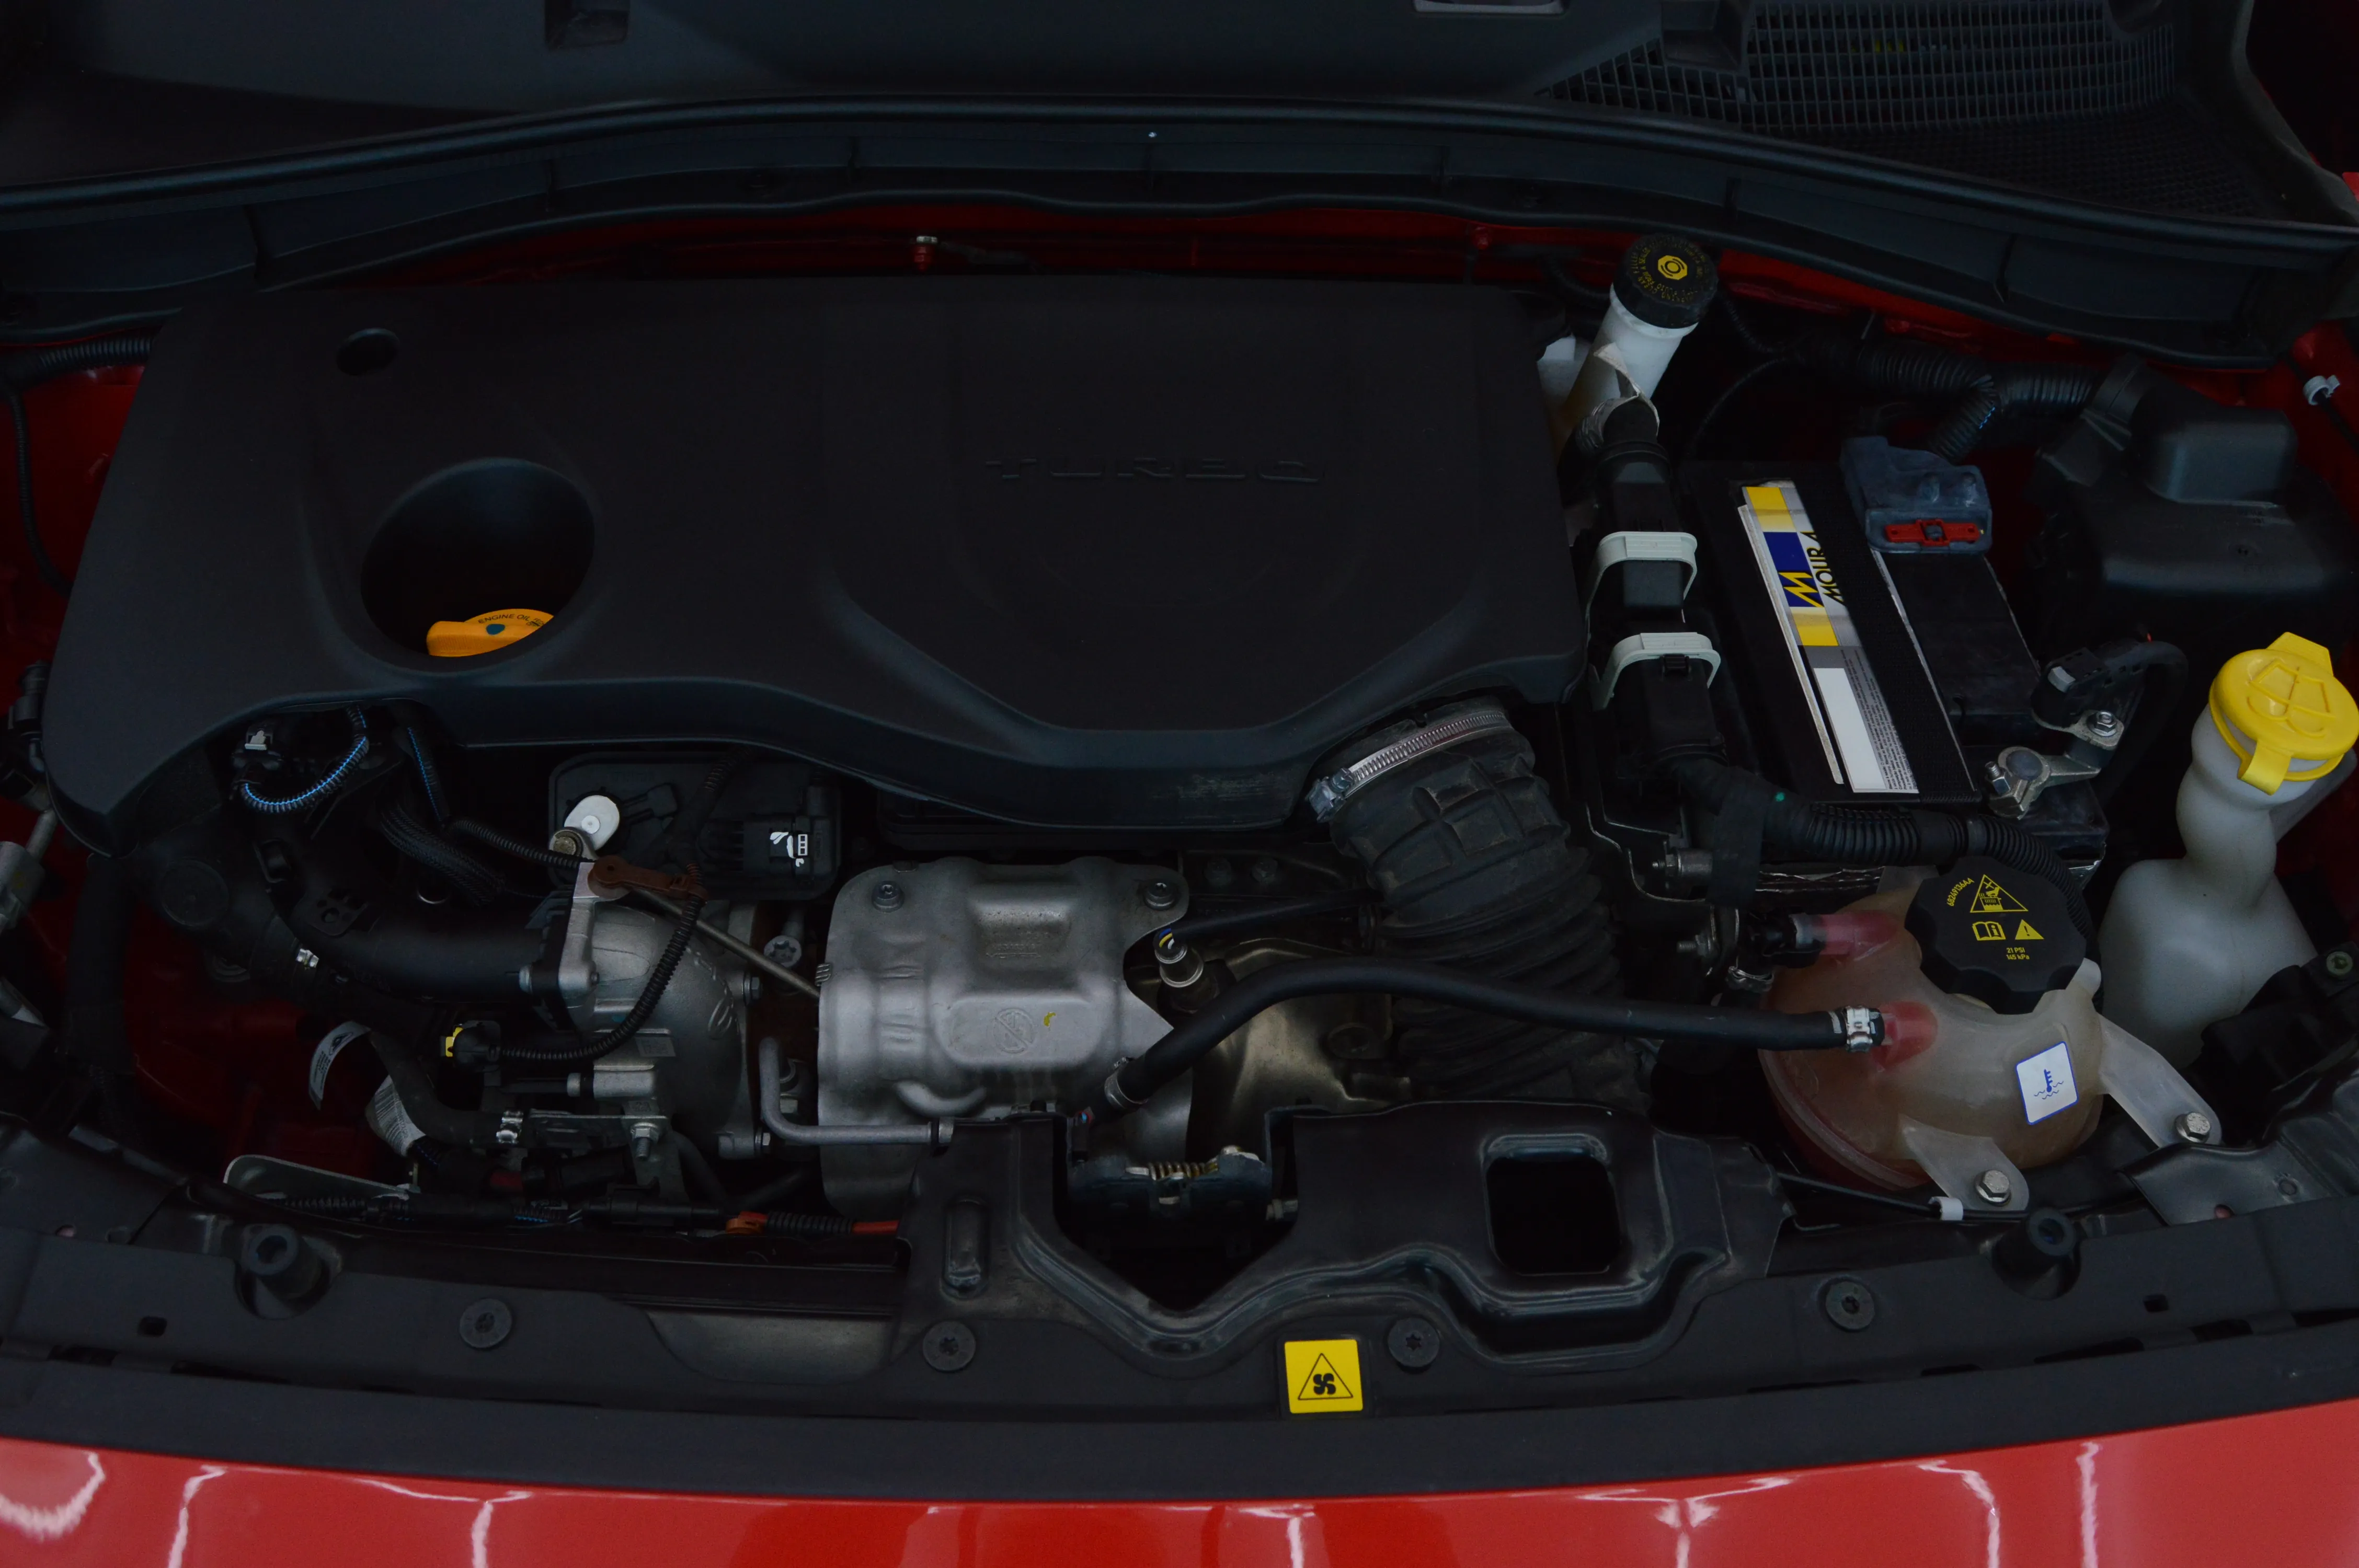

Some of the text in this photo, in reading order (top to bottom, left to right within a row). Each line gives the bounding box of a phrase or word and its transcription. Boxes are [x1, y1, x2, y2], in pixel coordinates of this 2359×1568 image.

[1800, 531, 1845, 603] MOURA
[478, 614, 514, 624] ENGINE
[1946, 877, 1975, 907] 68249136AA
